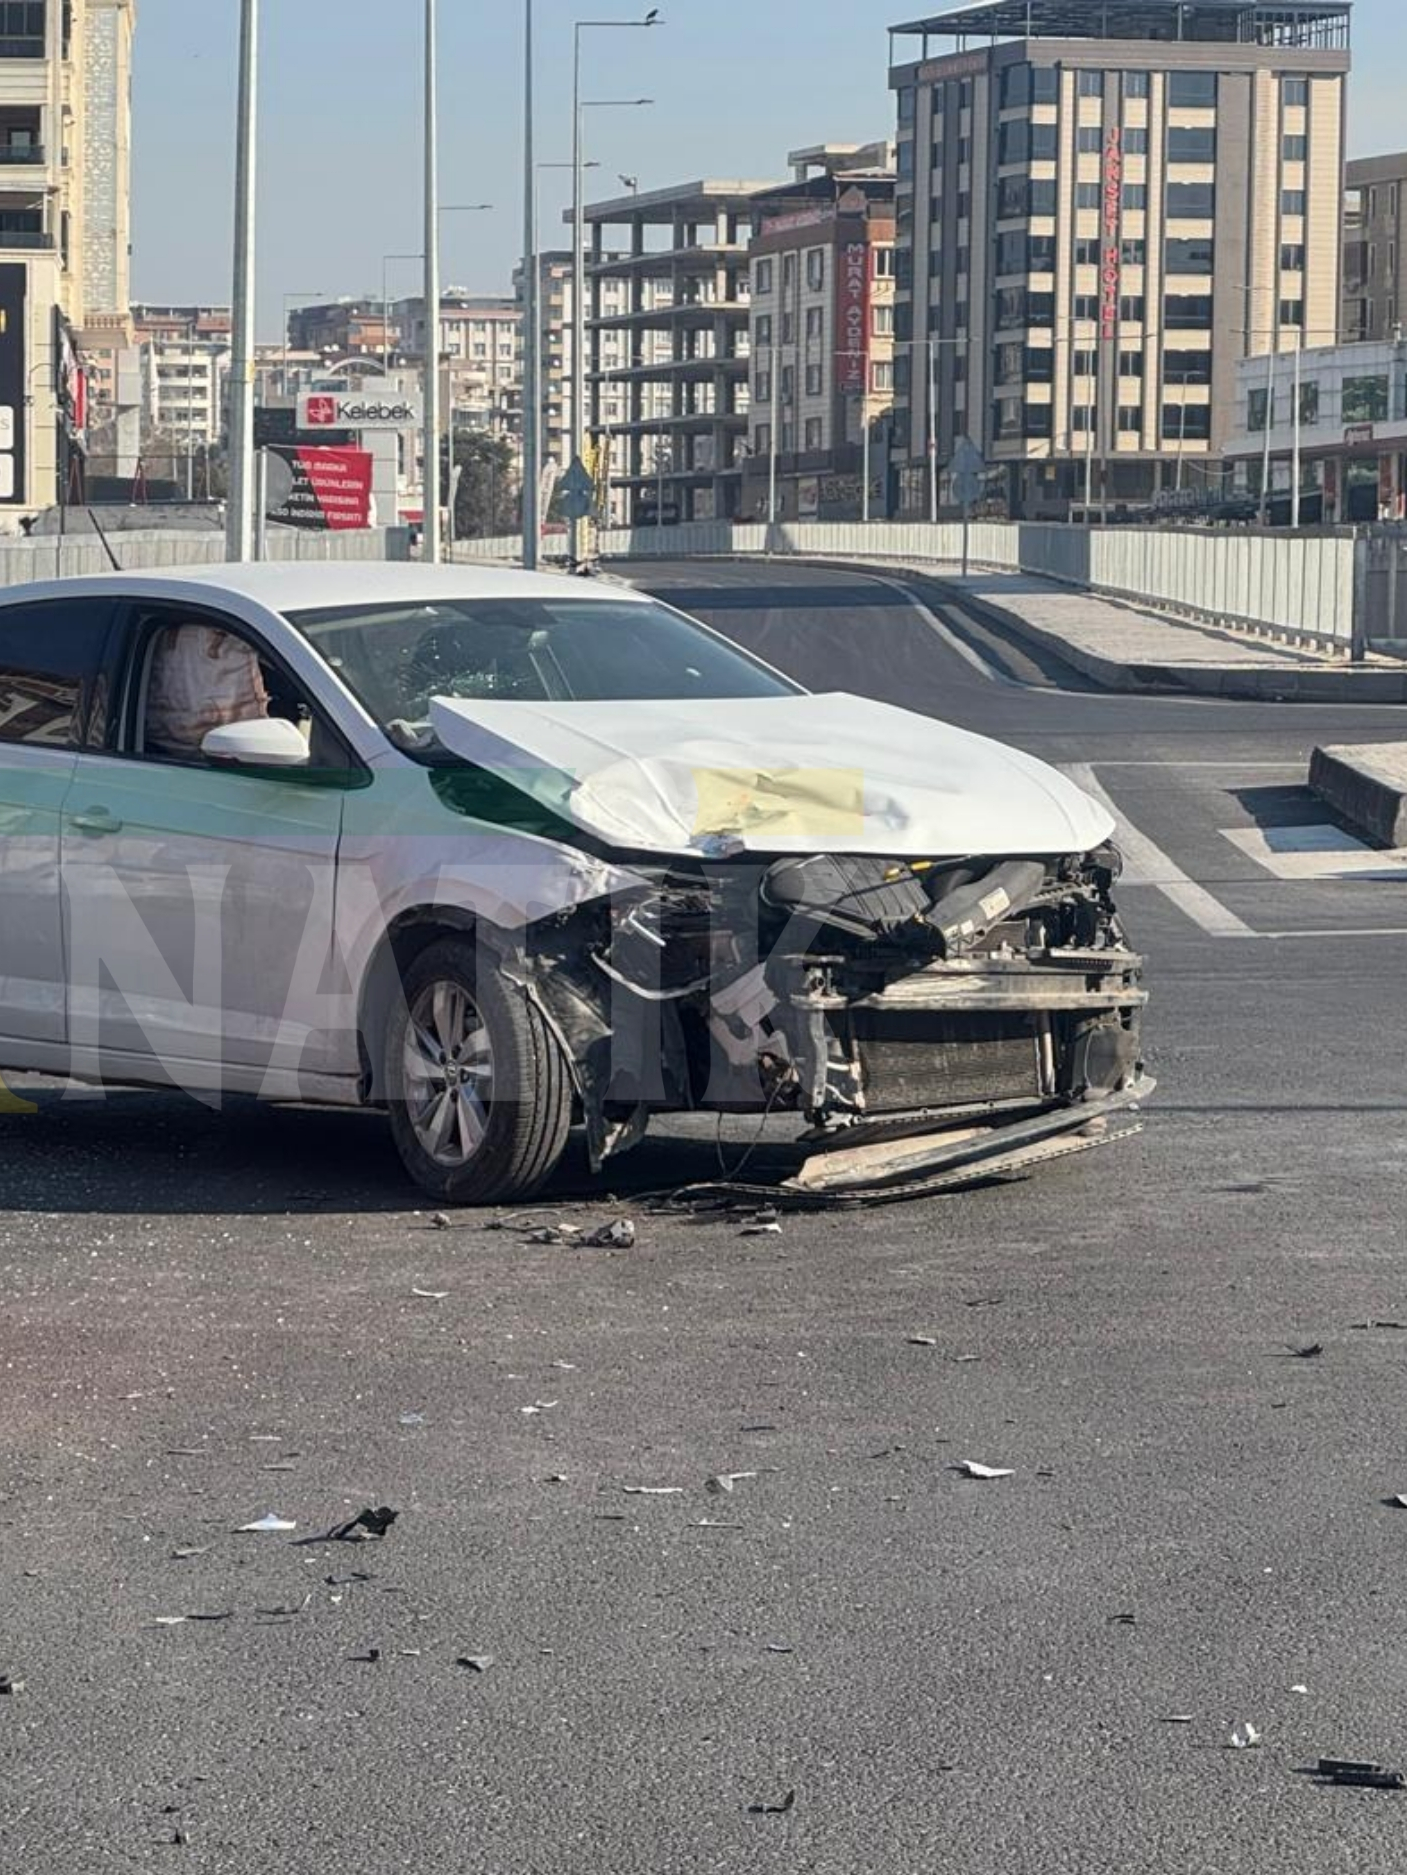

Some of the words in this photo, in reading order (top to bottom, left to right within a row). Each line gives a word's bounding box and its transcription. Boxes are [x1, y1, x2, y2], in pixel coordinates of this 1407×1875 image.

[847, 242, 864, 298] MURAT
[1102, 247, 1119, 340] HOTEL
[336, 401, 415, 420] Kelebek
